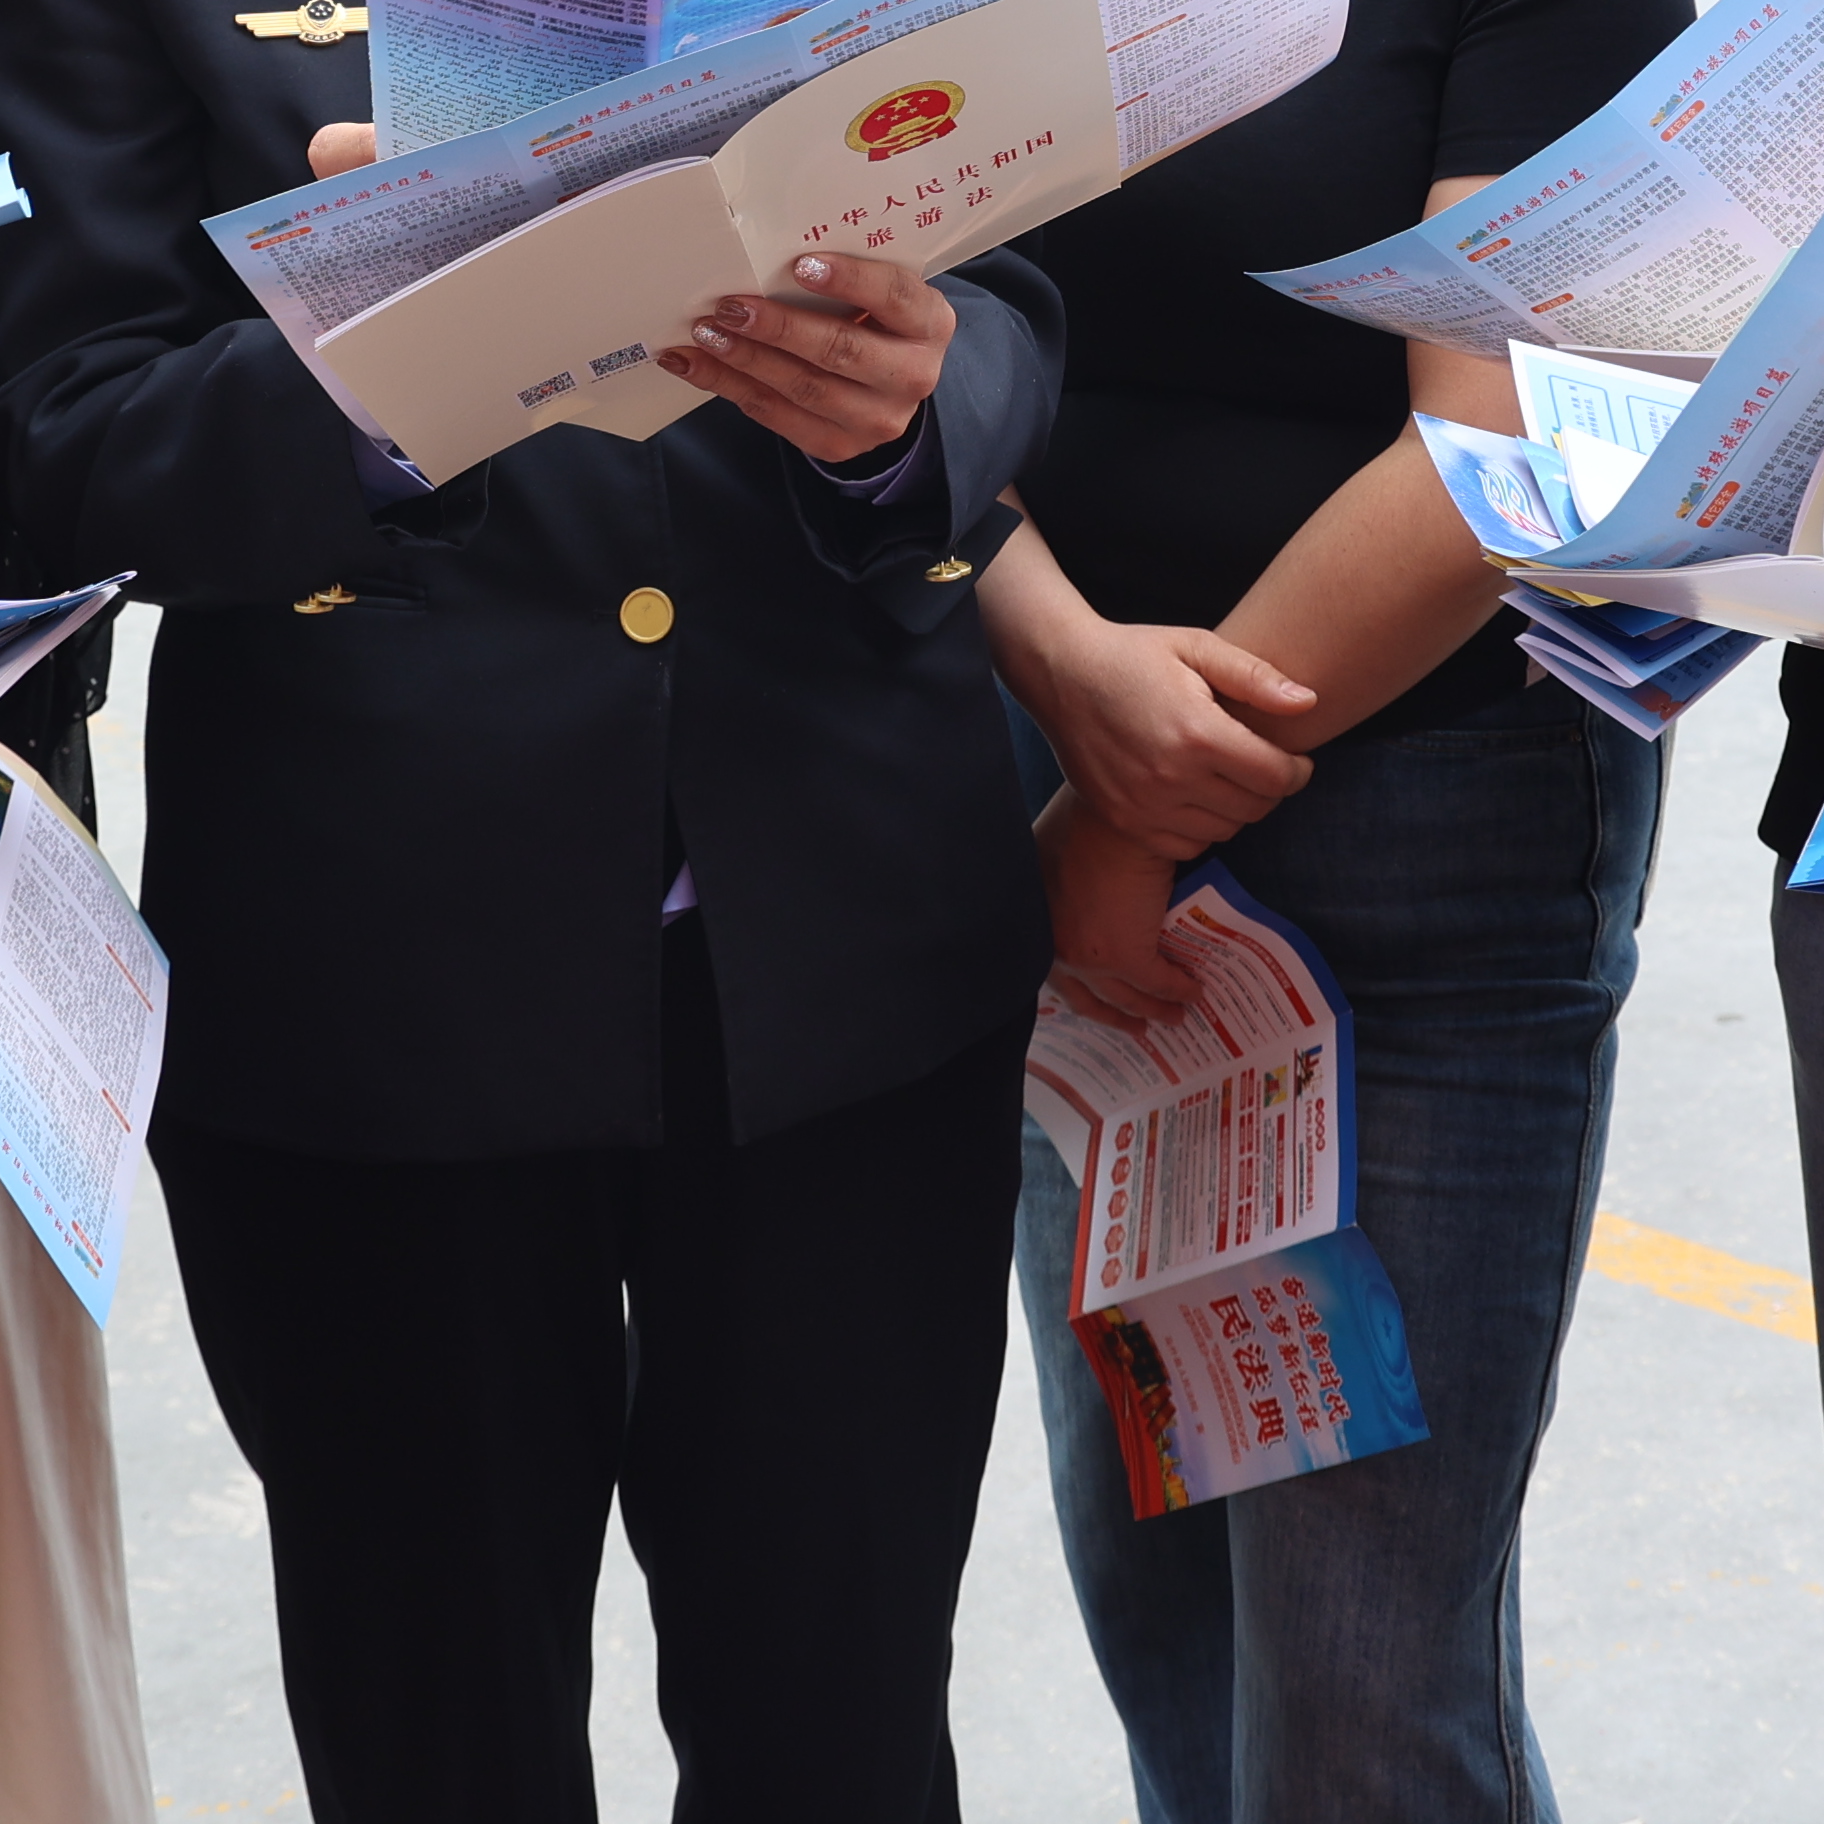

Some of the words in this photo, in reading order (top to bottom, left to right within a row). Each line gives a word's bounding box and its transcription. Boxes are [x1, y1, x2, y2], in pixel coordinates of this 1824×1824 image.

[1676, 1, 1780, 98] 特殊旅游项目篇
[575, 68, 718, 128] 特殊旅游项目篇
[1665, 105, 1698, 137] 其它安全
[290, 167, 436, 223] 特殊旅游项目篇
[799, 128, 1058, 246] 中华人民共和国
[861, 183, 997, 250] 旅游法
[1482, 166, 1587, 234] 特殊旅游项目篇
[1685, 366, 1793, 481] 特殊旅游项目篇
[1699, 488, 1737, 522] 其它安全
[1207, 1291, 1294, 1449] 民法典
[1249, 1281, 1328, 1436] 筑梦新征程
[1278, 1272, 1356, 1425] 奋进新时代
